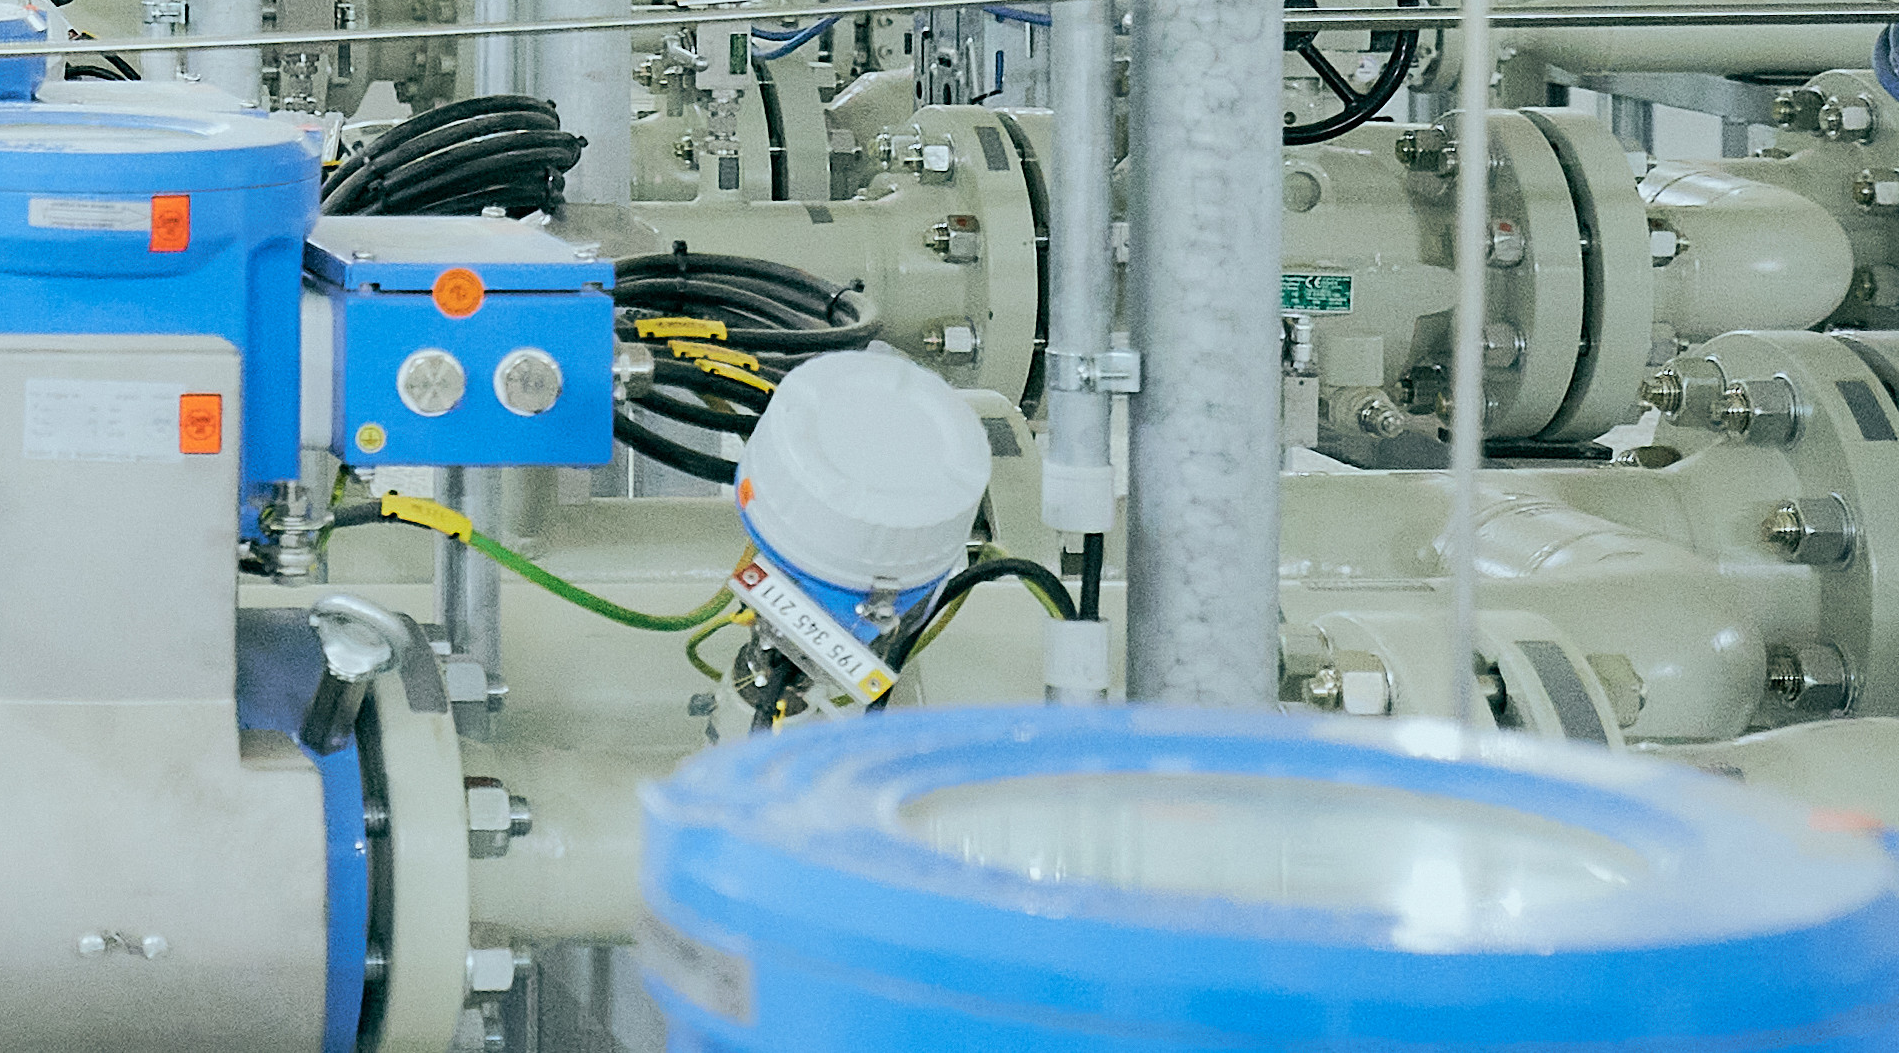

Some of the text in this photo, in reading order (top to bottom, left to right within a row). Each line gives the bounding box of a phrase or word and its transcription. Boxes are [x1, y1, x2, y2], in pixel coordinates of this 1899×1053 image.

[761, 584, 863, 676] T95 345 211
